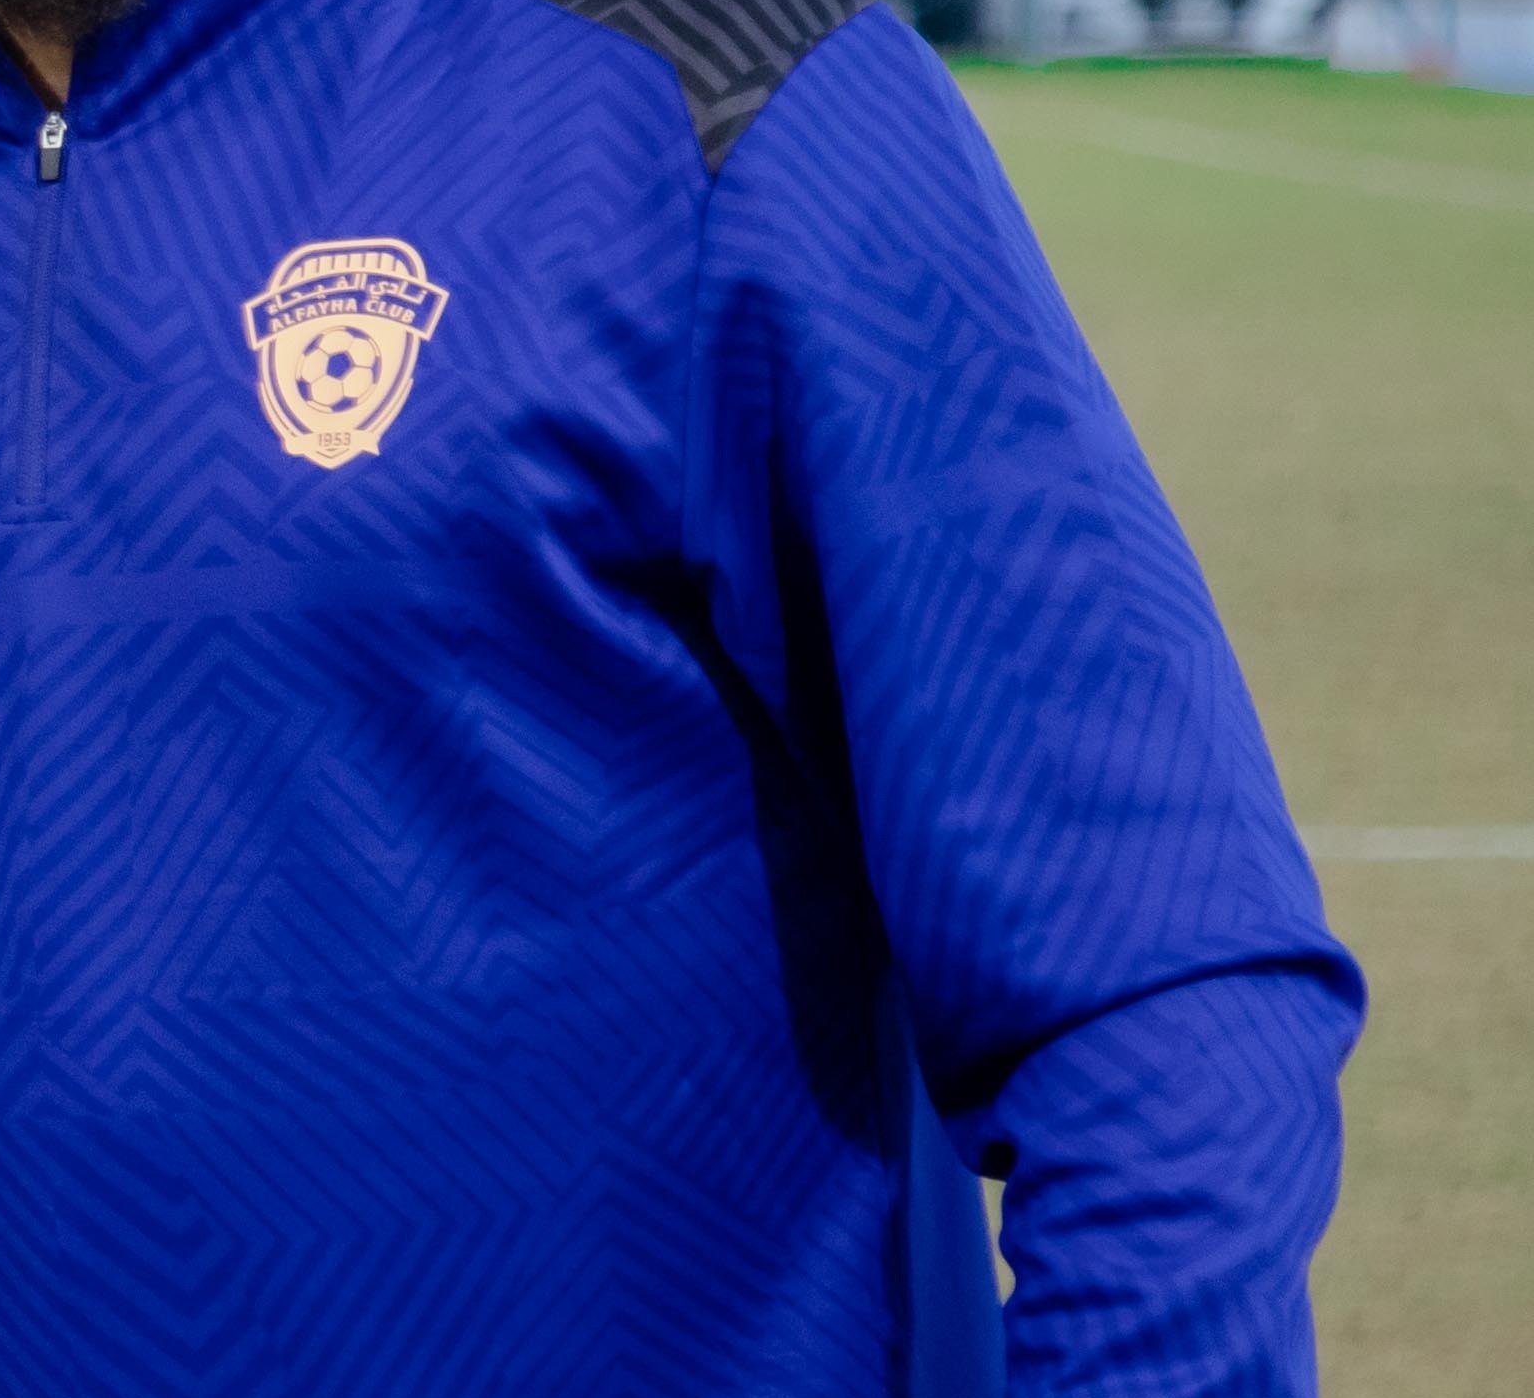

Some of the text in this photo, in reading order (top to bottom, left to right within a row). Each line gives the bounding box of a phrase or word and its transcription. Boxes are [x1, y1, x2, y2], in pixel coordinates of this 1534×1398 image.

[270, 298, 416, 333] ALFAYHA CLUB
[317, 432, 352, 447] 1953
